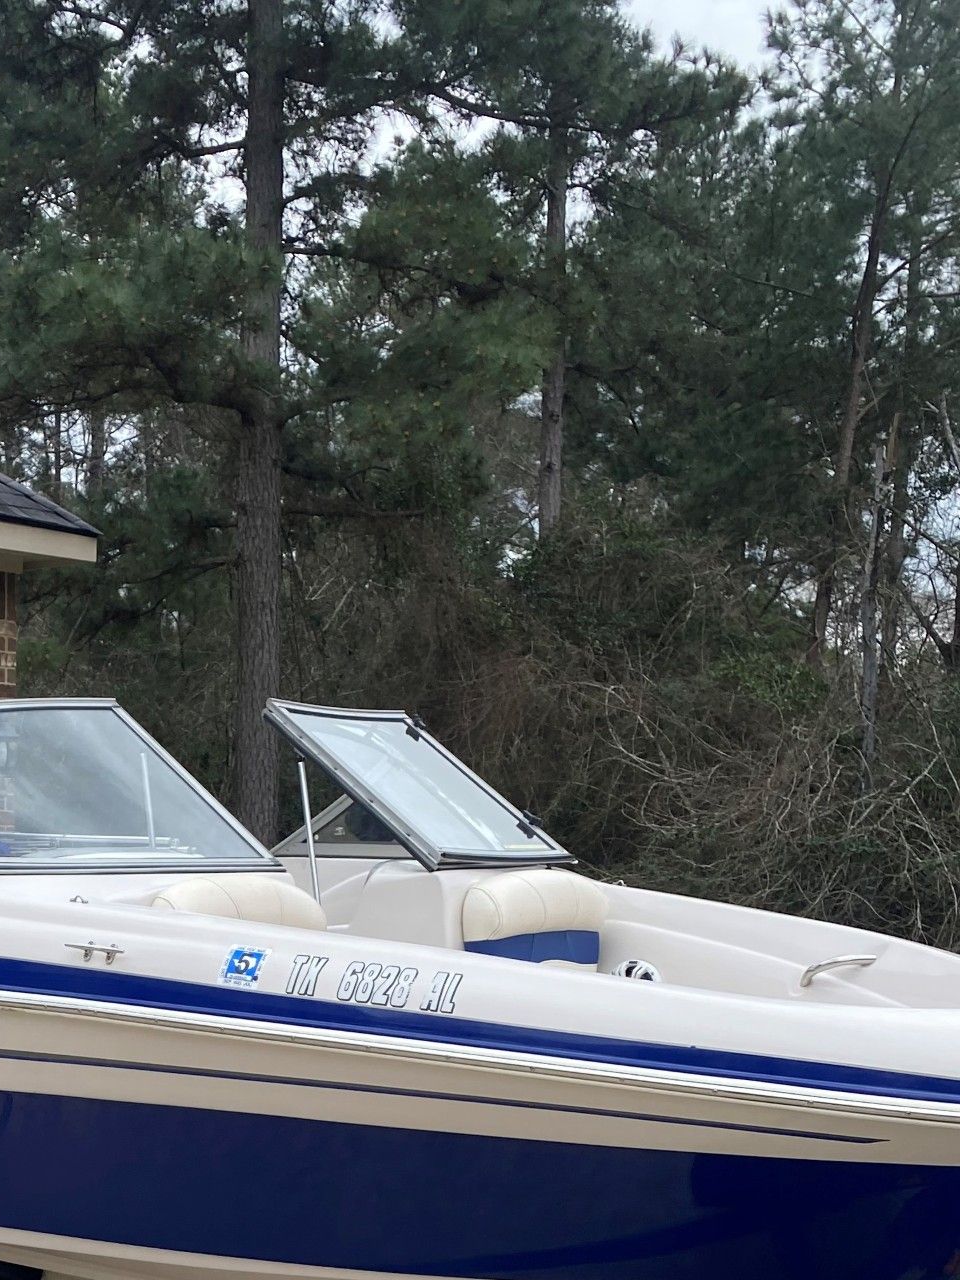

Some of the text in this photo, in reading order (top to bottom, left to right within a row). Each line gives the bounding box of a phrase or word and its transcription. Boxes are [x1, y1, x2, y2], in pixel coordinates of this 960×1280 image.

[285, 954, 329, 996] TX
[336, 960, 419, 1008] 6828
[419, 971, 464, 1014] AL
